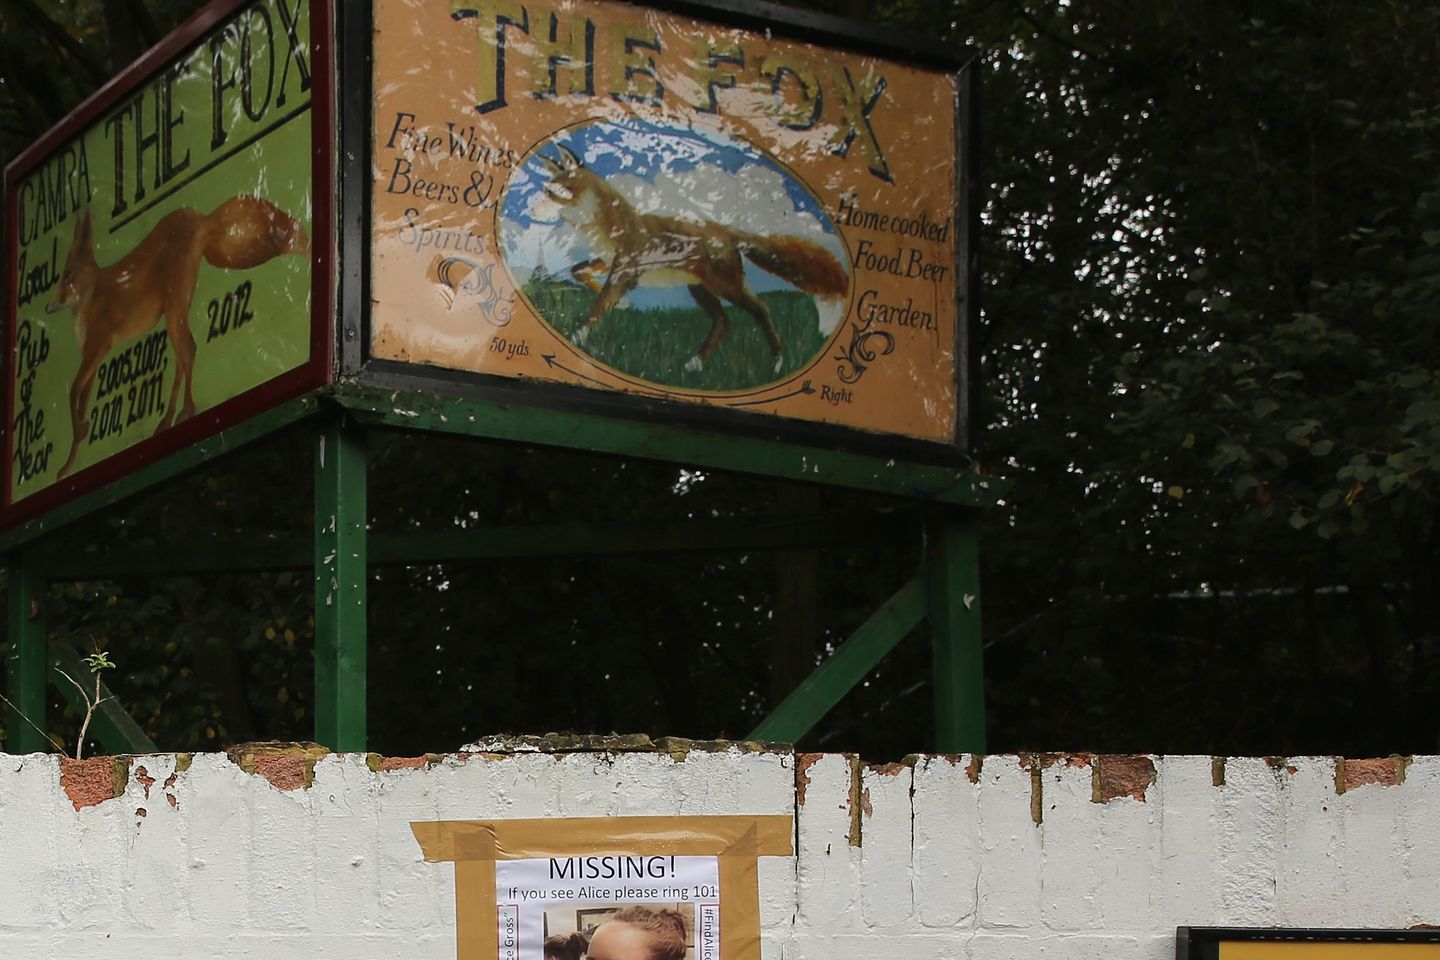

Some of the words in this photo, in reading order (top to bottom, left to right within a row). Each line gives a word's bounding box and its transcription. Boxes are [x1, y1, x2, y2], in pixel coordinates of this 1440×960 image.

[105, 61, 190, 219] THE
[211, 0, 311, 152] FOX
[451, 4, 664, 115] THE
[690, 34, 896, 185] FOX
[386, 112, 442, 155] Fine
[446, 122, 516, 169] Wines
[19, 134, 92, 247] CAMRA
[387, 158, 459, 204] Beers
[464, 170, 498, 208] &
[399, 208, 485, 253] Spirits
[835, 192, 888, 232] Home
[891, 211, 951, 243] cooked
[906, 249, 948, 283] Beer
[206, 280, 254, 344] 2012
[17, 320, 50, 378] Pub
[490, 337, 506, 353] 50
[821, 385, 852, 406] Right
[14, 404, 45, 451] The
[13, 442, 53, 485] Year
[549, 856, 675, 879] MISSING!
[509, 887, 517, 899] If
[522, 891, 547, 901] you
[552, 889, 574, 899] see
[578, 886, 610, 899] Alice
[615, 886, 659, 901] please
[662, 886, 689, 900] ring
[694, 885, 717, 897] 101
